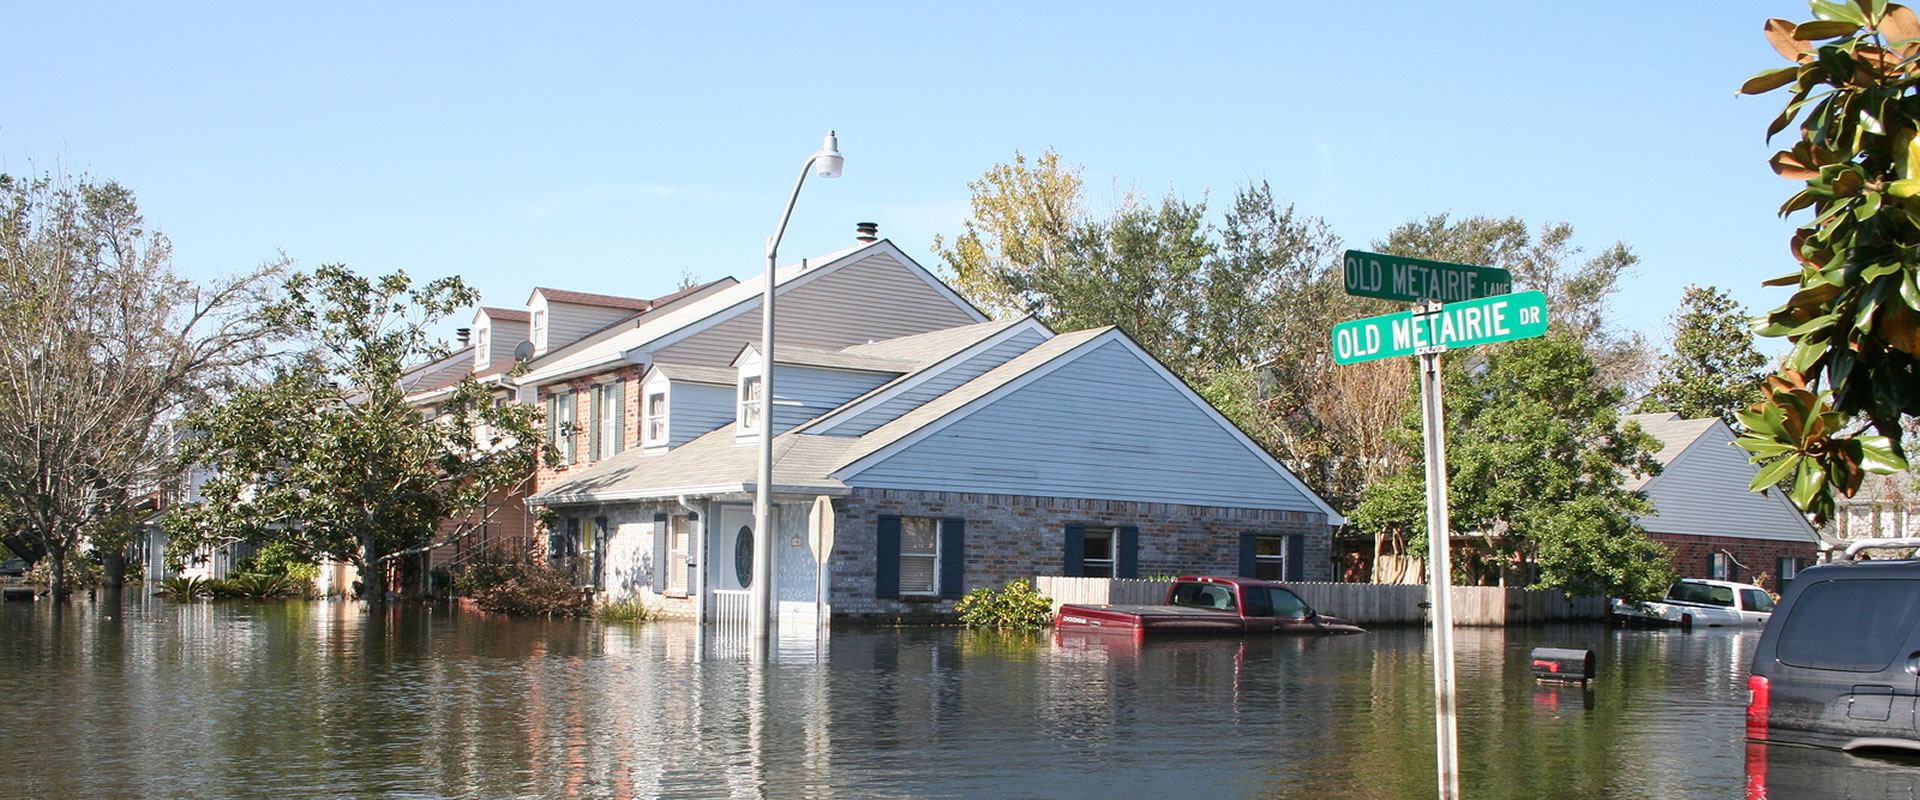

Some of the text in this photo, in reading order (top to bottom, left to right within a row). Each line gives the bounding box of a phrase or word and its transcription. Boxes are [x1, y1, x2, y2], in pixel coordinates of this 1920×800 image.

[1346, 258, 1510, 300] OLD METAIRIE LANE
[1337, 301, 1540, 360] OLD METAIRIE DR
